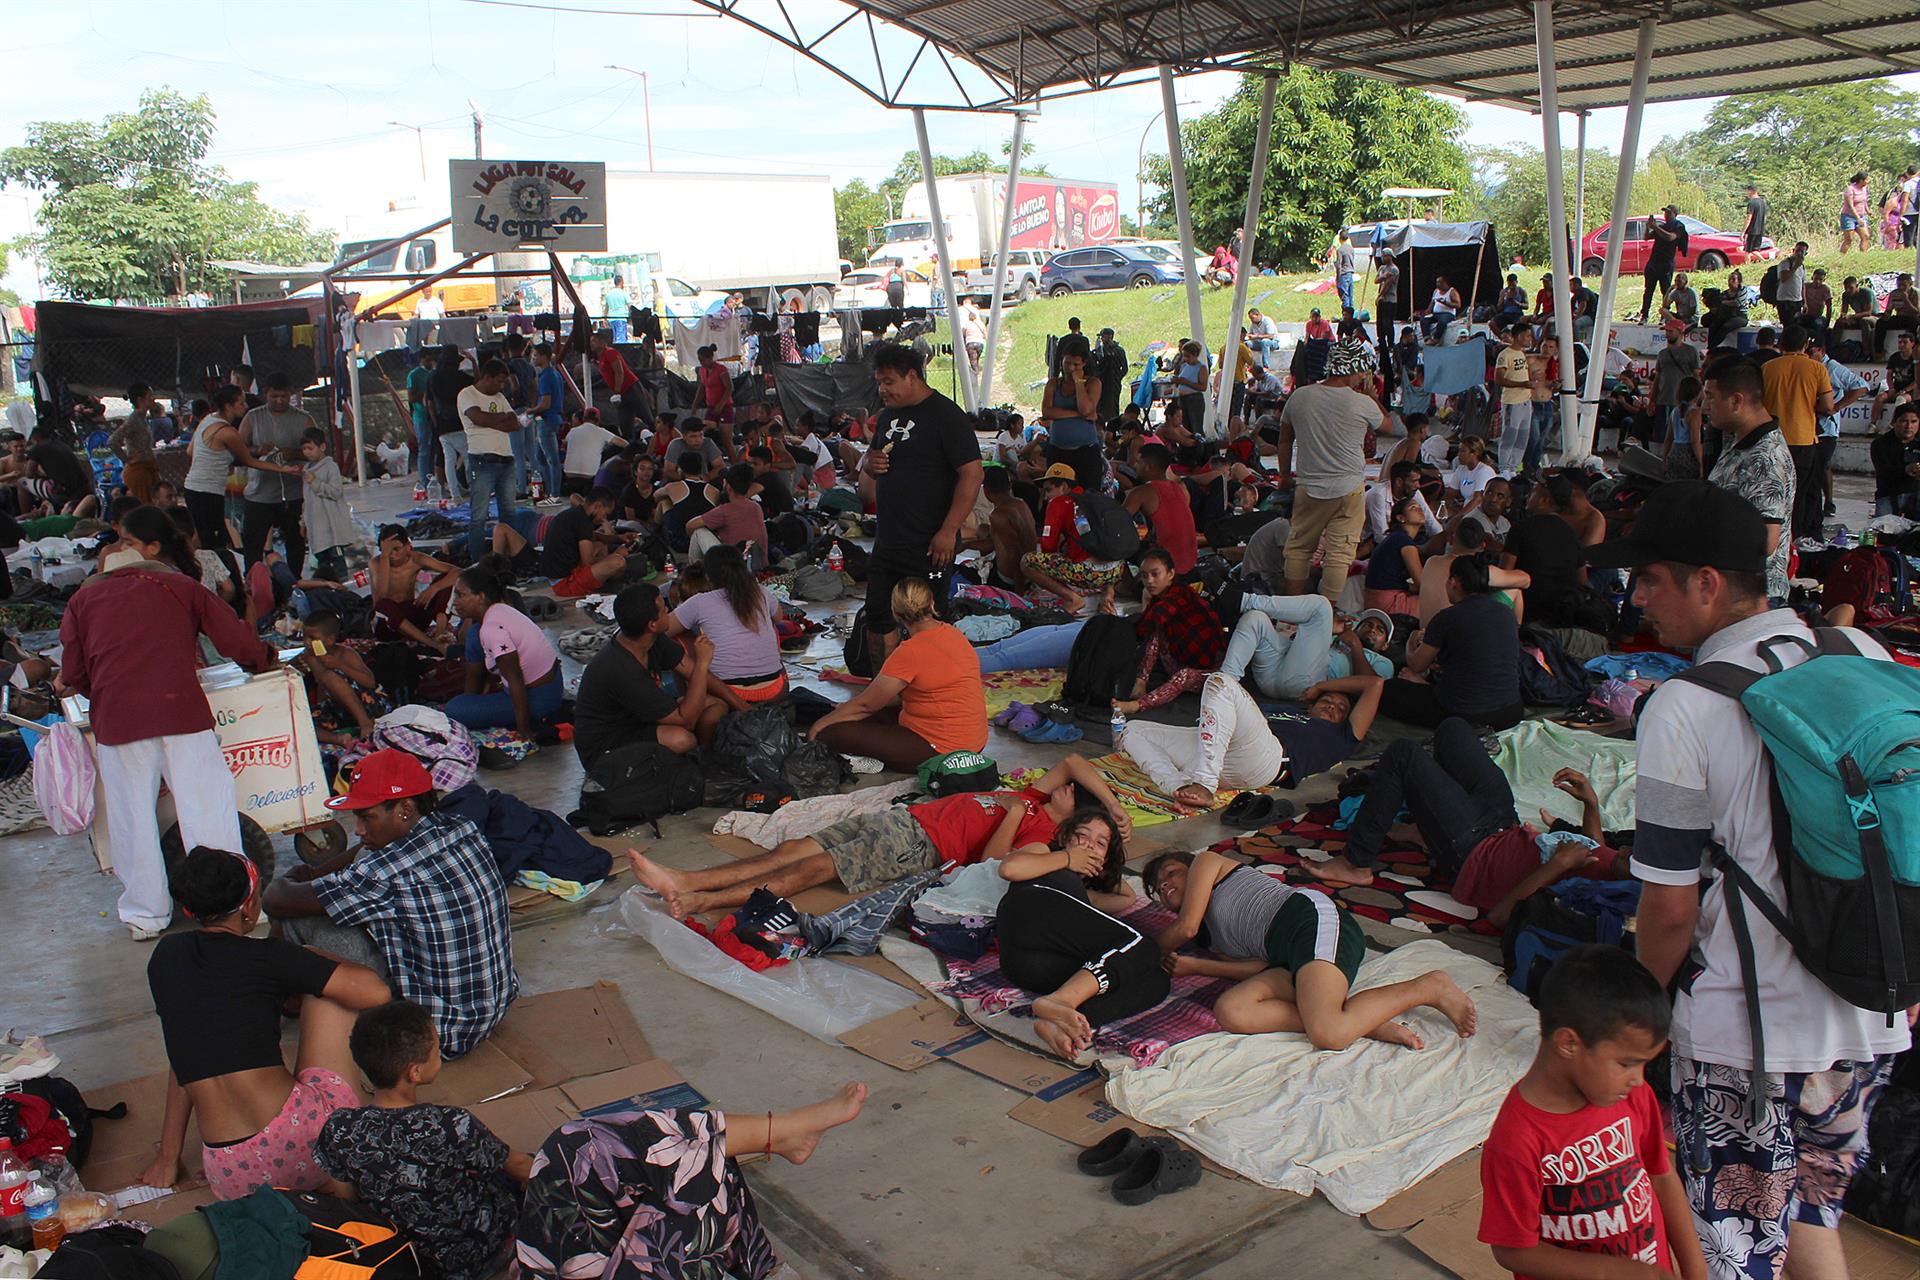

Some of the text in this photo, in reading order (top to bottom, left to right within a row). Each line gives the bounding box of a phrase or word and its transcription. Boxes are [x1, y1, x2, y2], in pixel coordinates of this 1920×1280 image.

[473, 163, 516, 195] LIGA
[1018, 194, 1046, 218] ANTOJO
[1026, 209, 1050, 230] BUENO
[1541, 1116, 1635, 1186] SORRY
[1541, 1205, 1628, 1241] MOM
